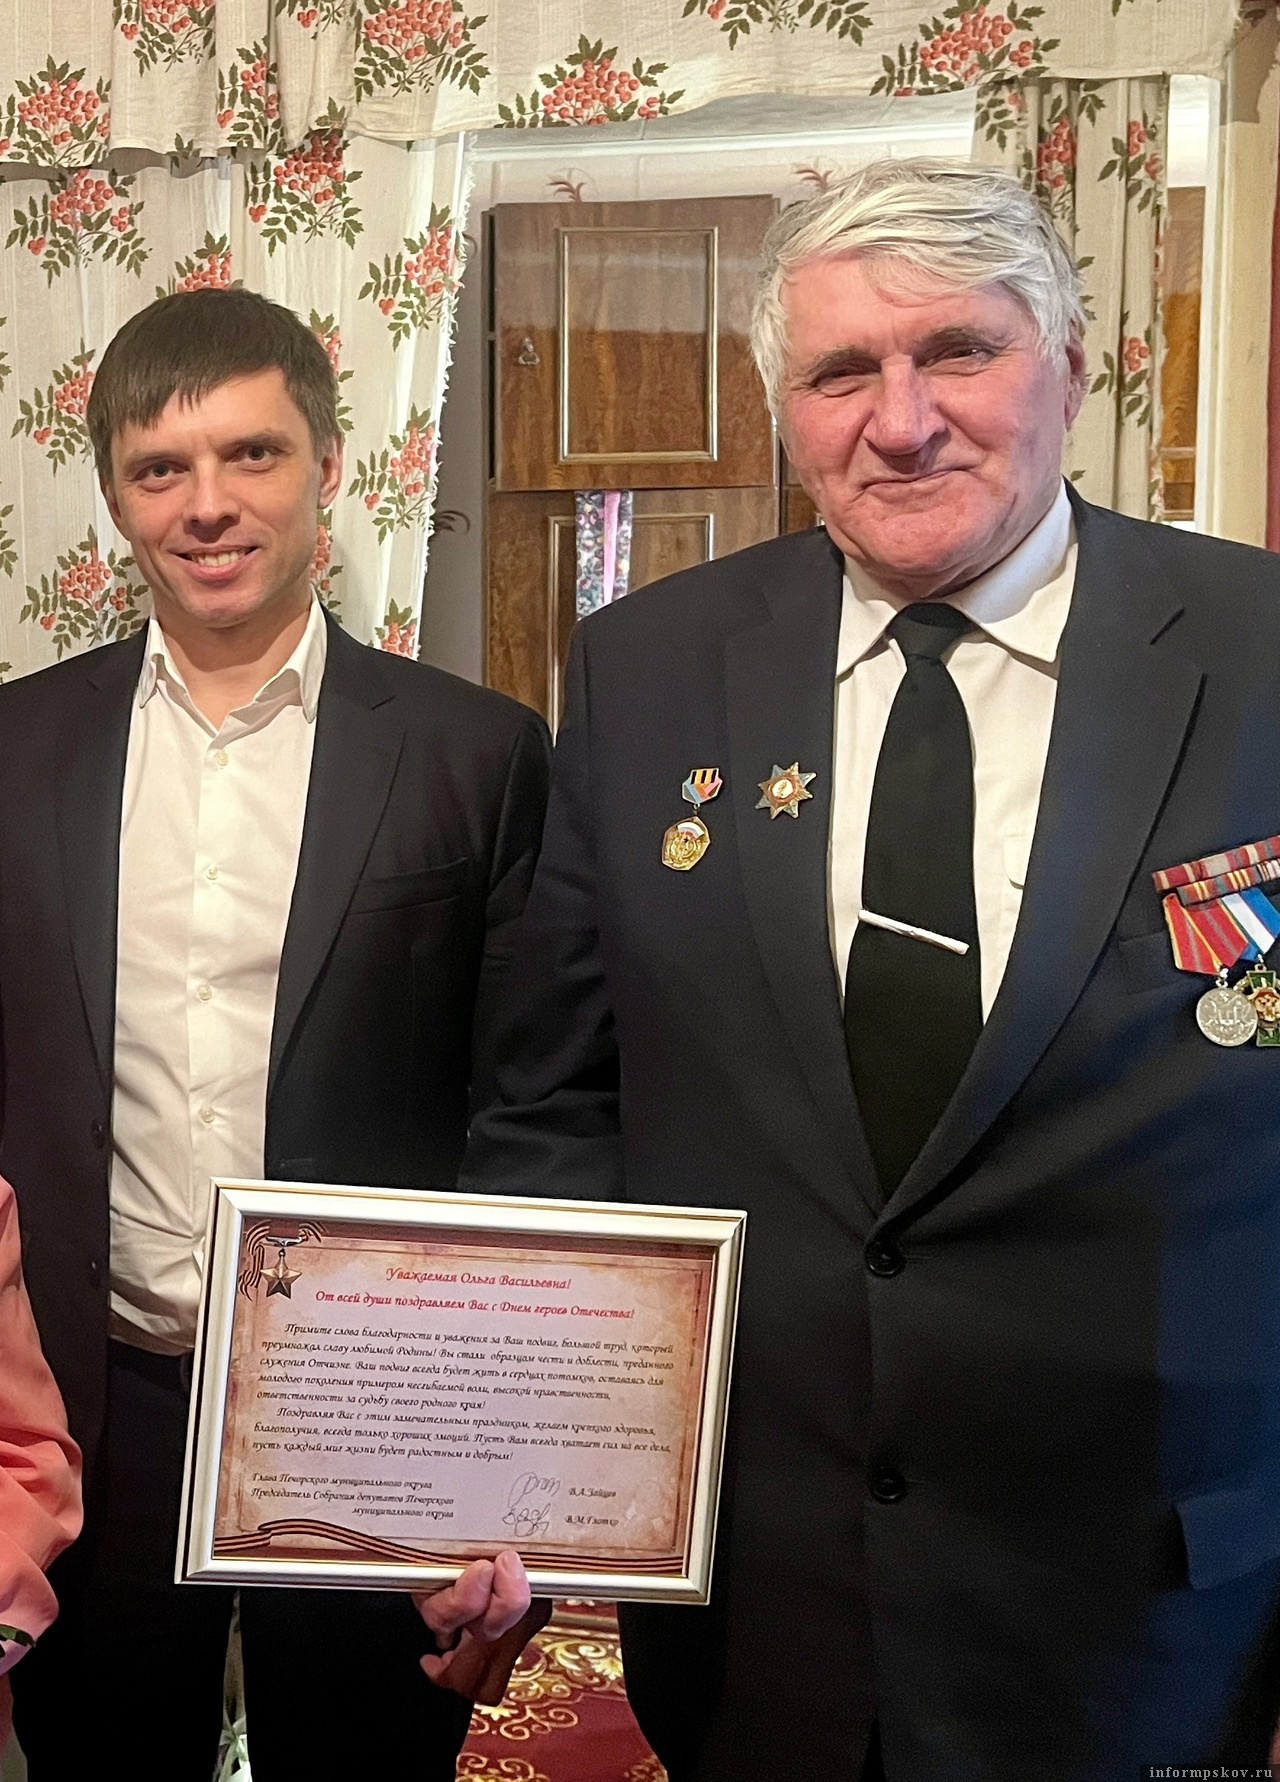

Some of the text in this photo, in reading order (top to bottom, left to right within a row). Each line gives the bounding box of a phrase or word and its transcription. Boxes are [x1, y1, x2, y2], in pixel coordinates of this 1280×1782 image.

[388, 1267, 571, 1289] Уважаемая Ольга Васильевна!
[315, 1290, 635, 1318] От всей души поздравляем Вас с Днем героев Отечества!
[284, 1323, 332, 1336] Примите
[334, 1328, 359, 1336] слова
[361, 1326, 432, 1341] благодарности
[442, 1334, 488, 1344] уважения
[504, 1335, 523, 1345] Ваш
[561, 1337, 601, 1349] большой
[631, 1344, 673, 1356] который
[323, 1344, 349, 1355] славу
[351, 1343, 394, 1355] любимой
[397, 1346, 437, 1356] Родины!
[440, 1348, 454, 1358] Вы
[538, 1356, 564, 1364] чести
[622, 1358, 674, 1371] преданного
[258, 1372, 302, 1384] молодого
[304, 1377, 354, 1387] поколения
[356, 1379, 404, 1391] примером
[406, 1379, 465, 1392] несгибаемой
[492, 1386, 531, 1396] высокой
[259, 1358, 305, 1369] служения
[356, 1361, 376, 1370] Ваш
[379, 1361, 410, 1372] подвиг
[412, 1363, 440, 1374] всегда
[442, 1364, 470, 1377] будет
[471, 1369, 499, 1378] жить
[509, 1369, 545, 1381] сердцах
[598, 1375, 645, 1384] оставаясь
[647, 1376, 664, 1386] для
[256, 1391, 343, 1402] ответственности
[357, 1394, 389, 1407] судьбу
[390, 1398, 419, 1406] своего
[420, 1397, 457, 1410] родного
[459, 1400, 486, 1412] края!
[336, 1410, 354, 1419] Вас
[364, 1413, 391, 1421] этим
[392, 1415, 470, 1425] замечательным
[533, 1421, 569, 1431] желаем
[570, 1423, 612, 1434] крепкого
[323, 1426, 352, 1436] всегда
[354, 1429, 389, 1440] только
[391, 1431, 431, 1441] хороших
[474, 1433, 504, 1446] Пусть
[509, 1435, 528, 1444] Вам
[530, 1436, 558, 1446] всегда
[561, 1440, 600, 1448] хватает
[620, 1442, 632, 1450] на
[633, 1443, 647, 1451] все
[252, 1442, 281, 1452] пусть
[283, 1440, 322, 1452] каждый
[344, 1445, 376, 1455] жизни
[377, 1443, 406, 1458] будет
[407, 1447, 463, 1458] радостным
[472, 1448, 513, 1462] добрым!
[252, 1472, 277, 1482] Глава
[278, 1473, 329, 1486] Печорского
[403, 1481, 432, 1491] округа
[251, 1487, 454, 1507] Председатель Собрания депутатов Печорского
[425, 1510, 454, 1520] округа
